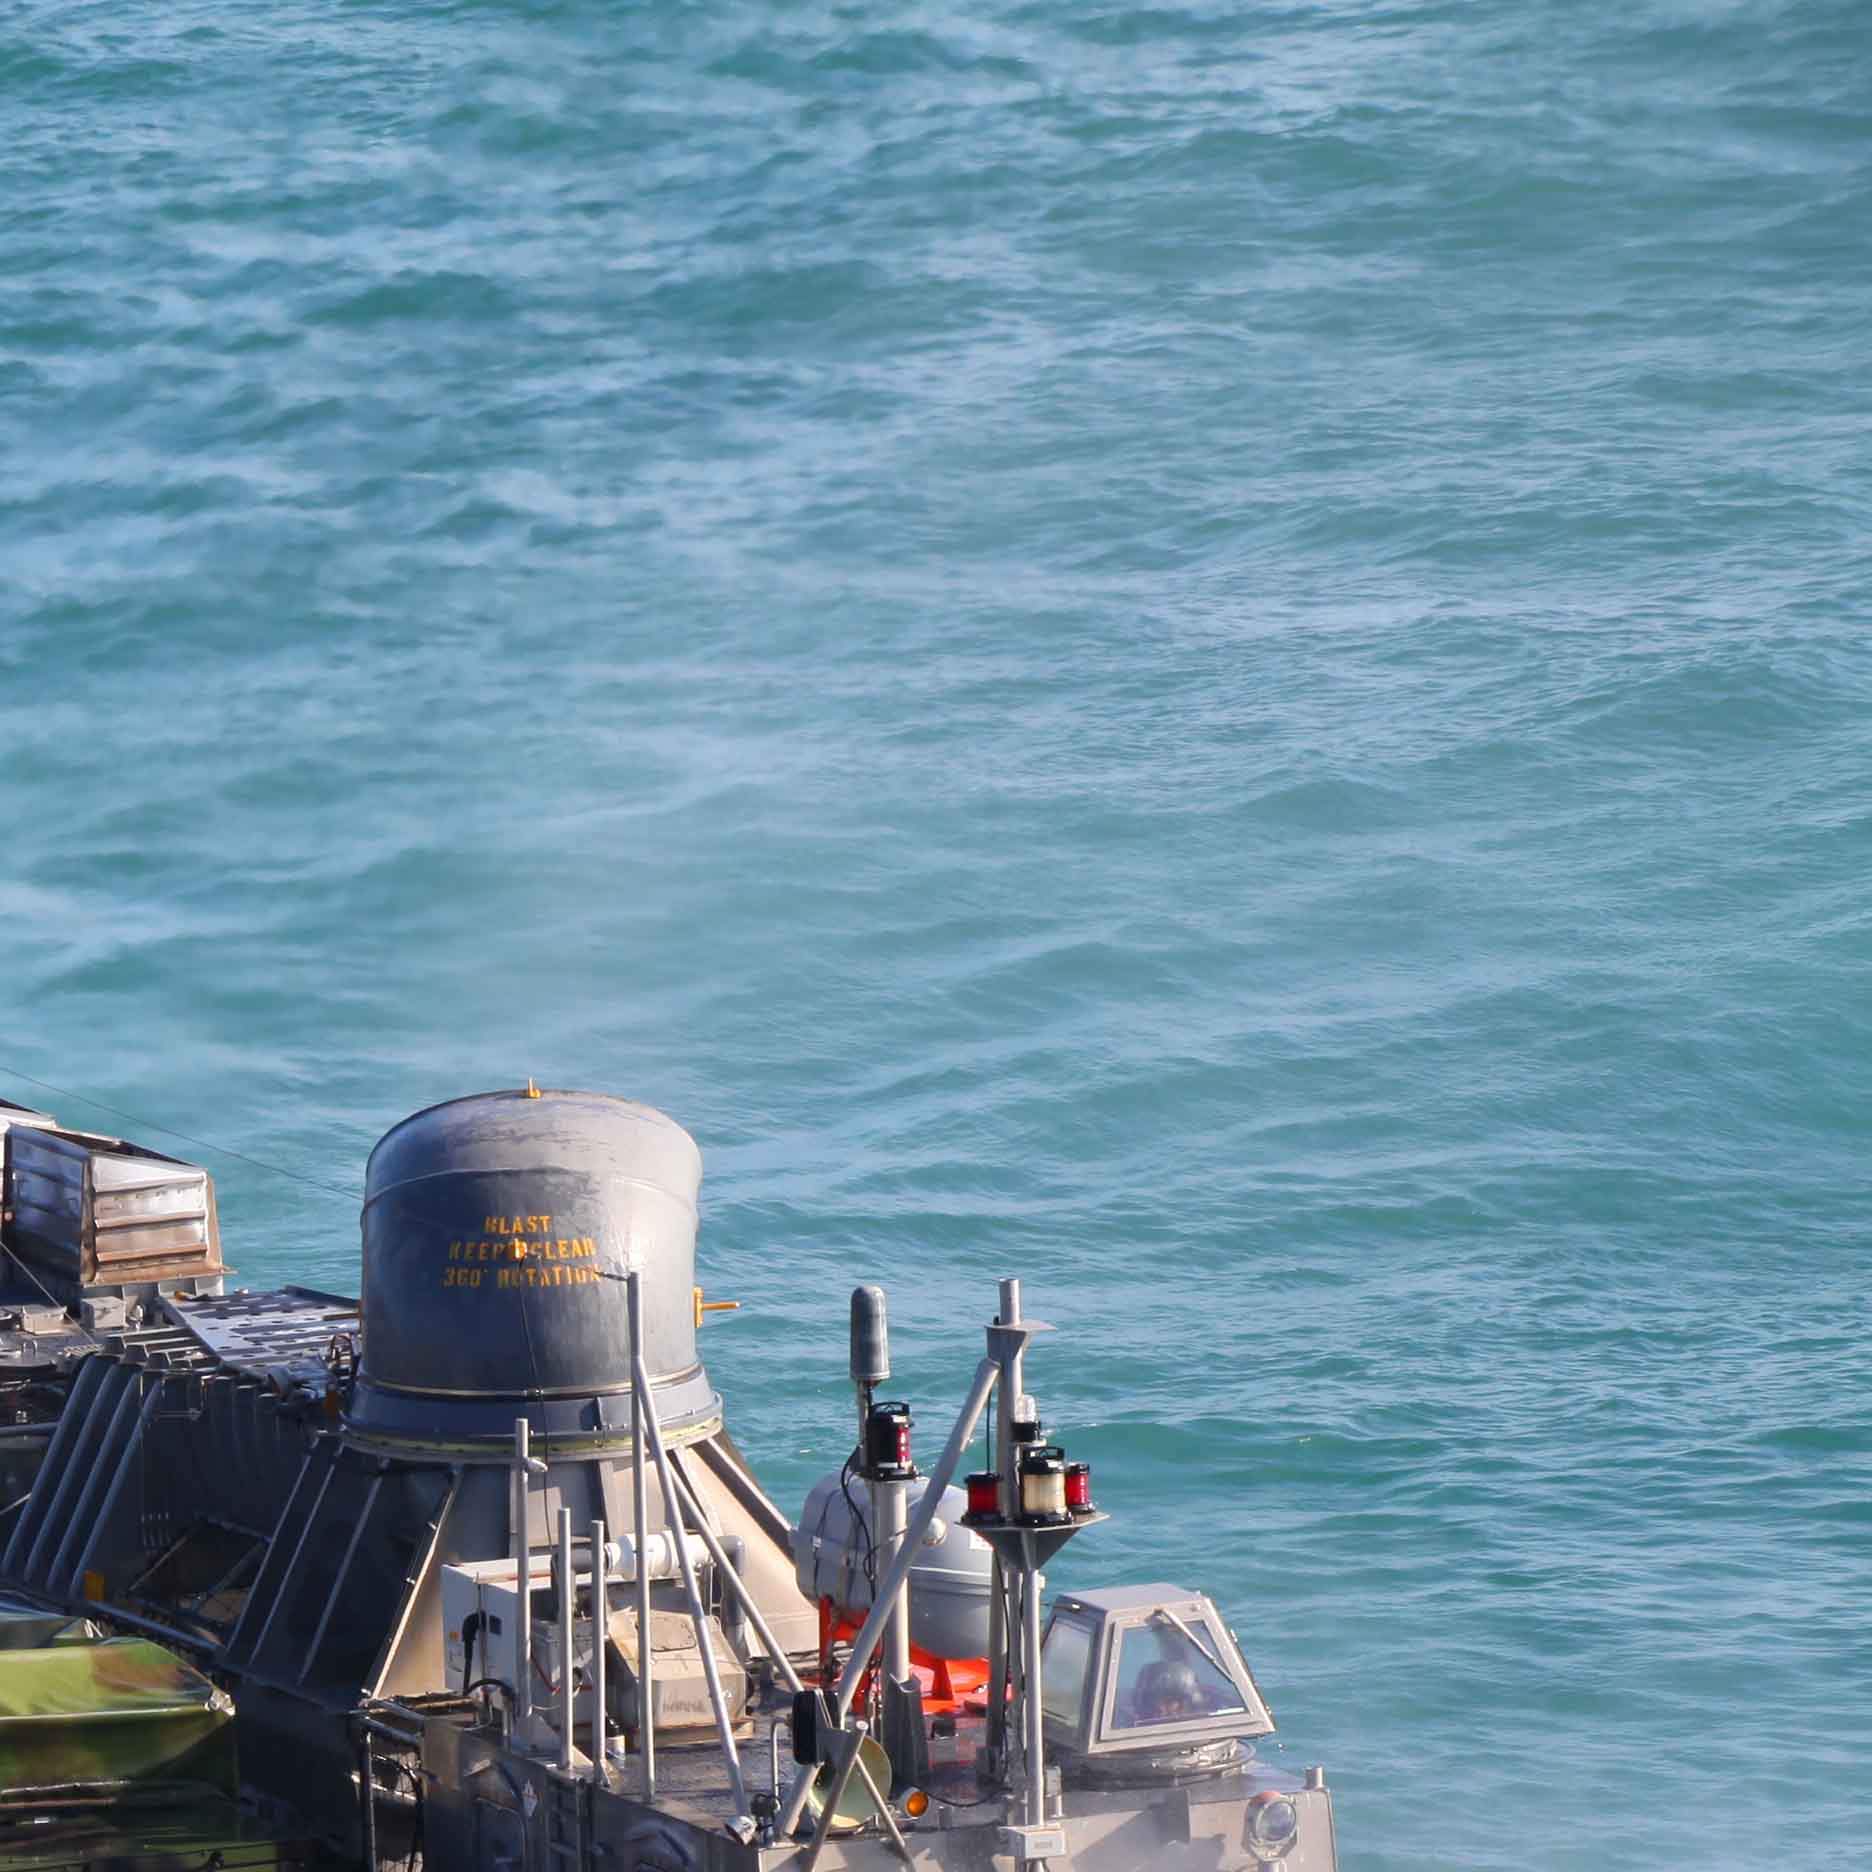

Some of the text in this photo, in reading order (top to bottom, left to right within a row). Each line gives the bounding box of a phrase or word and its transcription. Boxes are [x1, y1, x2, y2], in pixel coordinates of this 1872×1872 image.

[484, 1215, 552, 1235] BLAST
[448, 1237, 597, 1261] KEEP CLEAR
[497, 1263, 602, 1289] ROTATION
